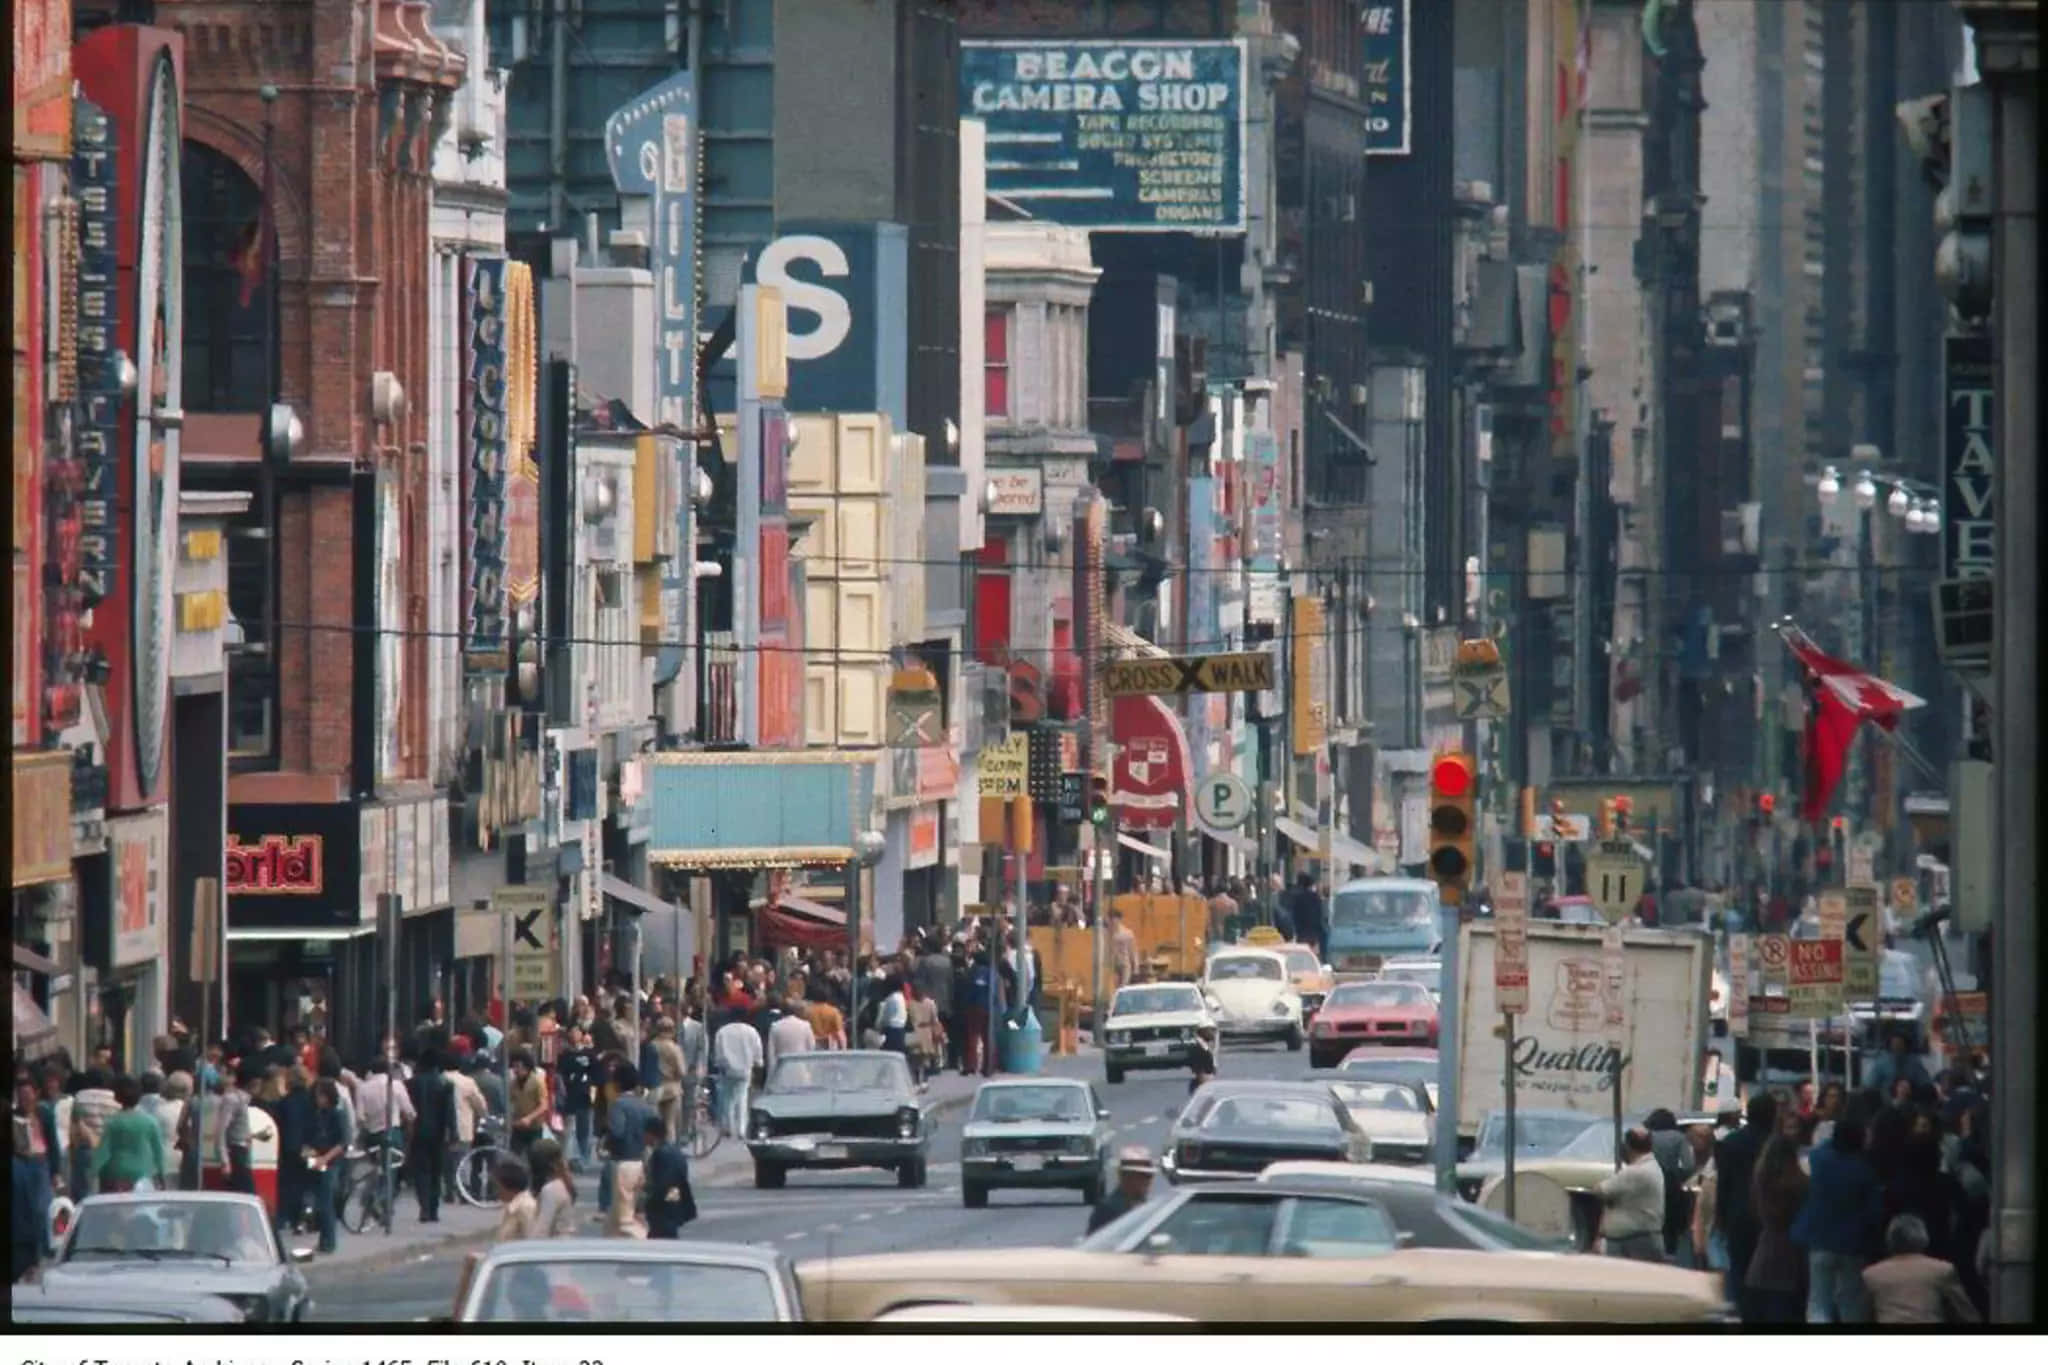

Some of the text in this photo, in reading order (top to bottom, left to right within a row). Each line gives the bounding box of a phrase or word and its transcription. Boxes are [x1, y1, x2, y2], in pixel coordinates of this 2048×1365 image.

[1015, 50, 1194, 80] BEACON
[972, 80, 1228, 111] CAMERA SHOP
[1951, 389, 1994, 579] TAVE
[1105, 664, 1174, 691] CROSS
[1210, 656, 1269, 688] WALK
[225, 835, 322, 893] orld
[1798, 944, 1825, 961] NO
[1512, 1036, 1631, 1092] Quality
